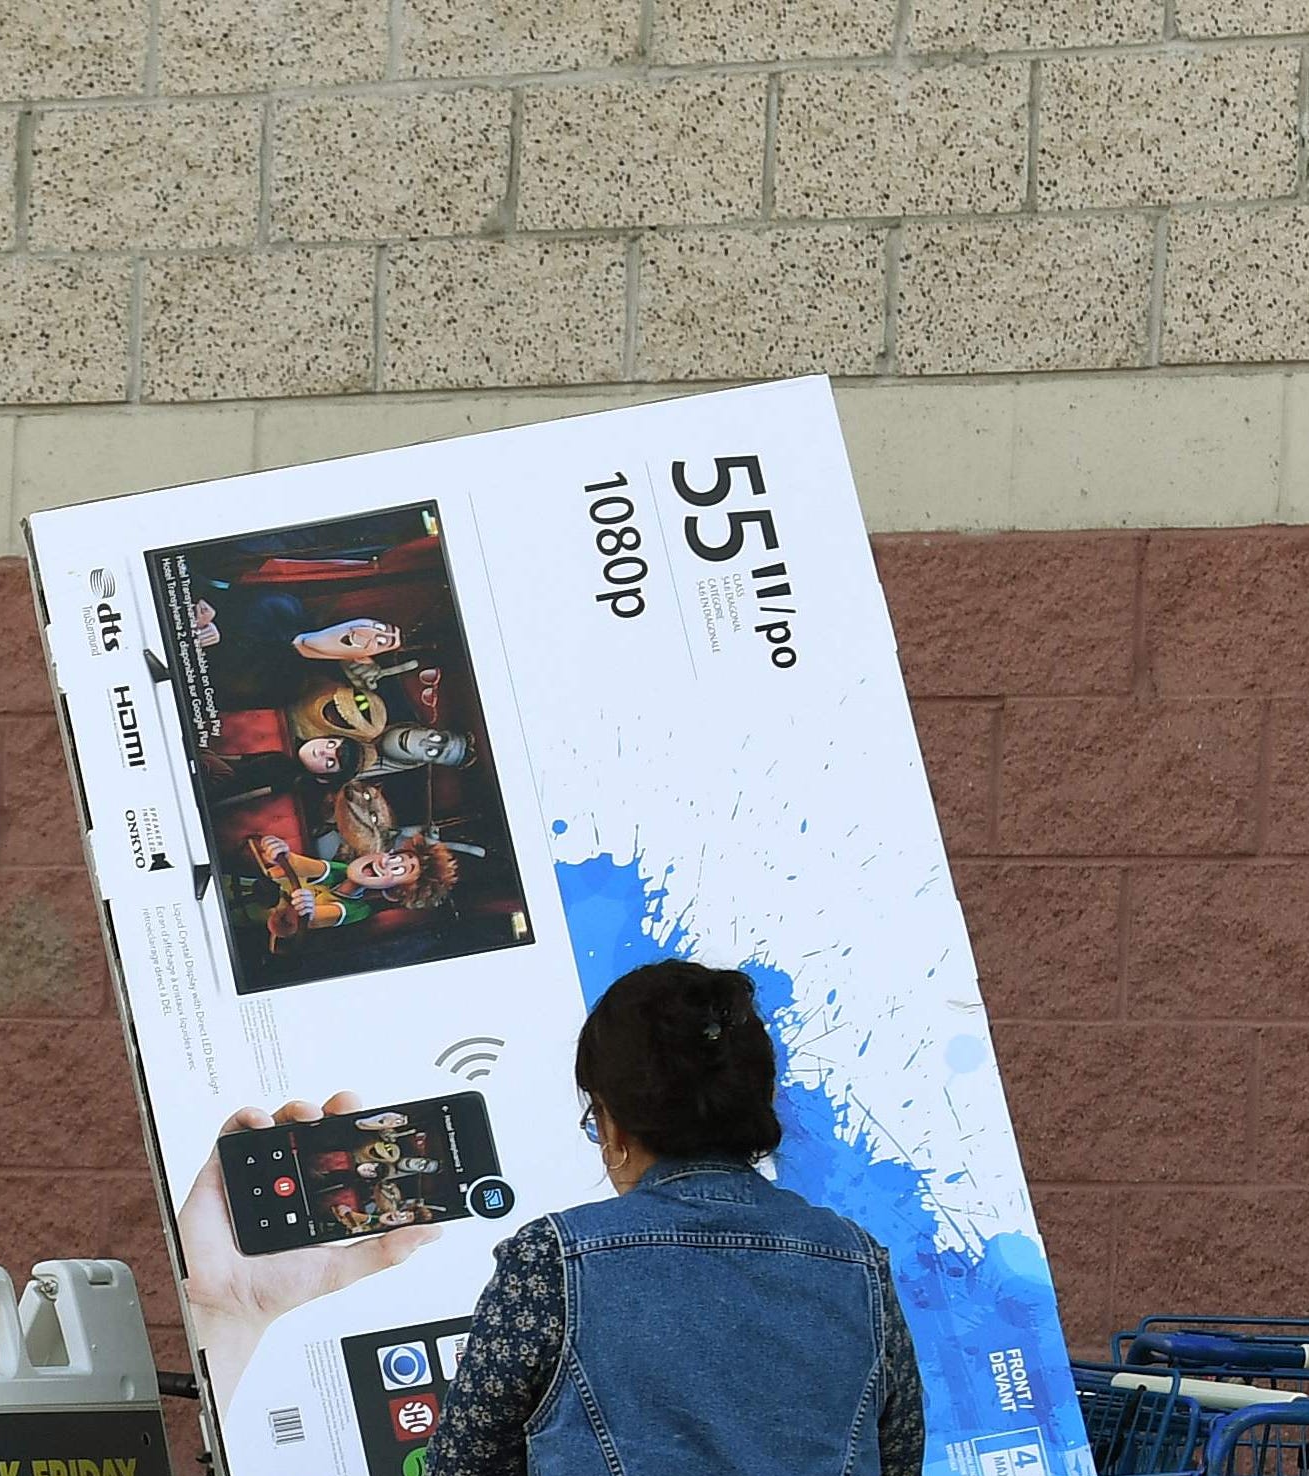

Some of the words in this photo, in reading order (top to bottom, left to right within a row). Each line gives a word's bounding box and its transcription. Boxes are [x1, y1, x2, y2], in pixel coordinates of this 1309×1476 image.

[584, 471, 648, 618] 1080p
[160, 557, 174, 581] Hotel
[175, 554, 189, 578] Hotel
[163, 581, 185, 631] Transylvania
[177, 578, 200, 629] Transylvania
[97, 602, 122, 652] dts
[176, 631, 186, 640] 2,
[191, 628, 201, 637] 2,
[175, 640, 196, 684] disponible
[191, 637, 209, 674] available
[187, 684, 197, 698] sur
[200, 675, 210, 687] on
[188, 697, 206, 730] Google
[201, 687, 219, 718] Google
[113, 685, 146, 768] HDMI
[195, 730, 210, 749] Play
[208, 718, 222, 737] Play
[123, 809, 147, 869] ONKYO
[140, 807, 156, 853] INSTALLED
[148, 806, 163, 846] SPEAKER
[170, 901, 186, 930] Liquid
[175, 929, 192, 960] Crystal
[181, 959, 199, 991] Display
[190, 990, 203, 1010] with
[194, 1010, 209, 1037] Direct
[200, 1037, 212, 1056] LED
[203, 1055, 222, 1096] Backlight
[988, 1350, 1016, 1414] DEVANT
[1006, 1347, 1032, 1402] FRONT
[399, 1401, 433, 1433] SHO
[1011, 1447, 1038, 1469] 4
